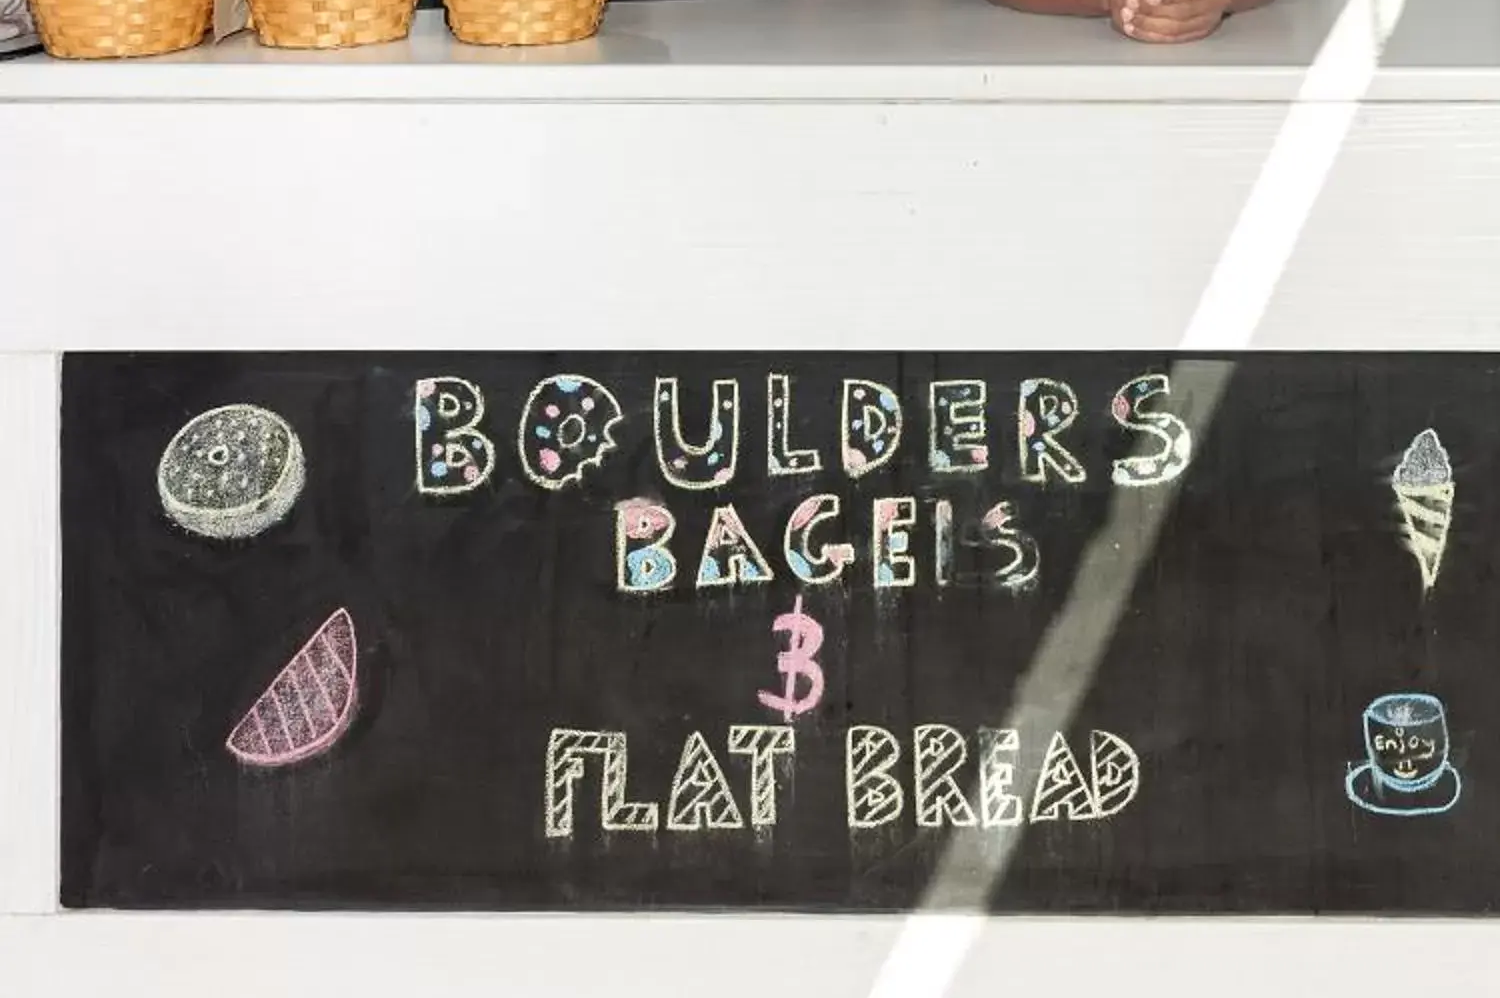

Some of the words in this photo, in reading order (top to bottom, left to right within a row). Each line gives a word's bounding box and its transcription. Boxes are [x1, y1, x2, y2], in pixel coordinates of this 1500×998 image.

[414, 373, 1194, 494] BOULDERS
[544, 724, 796, 839] FLAT
[846, 724, 1142, 830] BREAD
[1374, 726, 1435, 760] Enjoy
